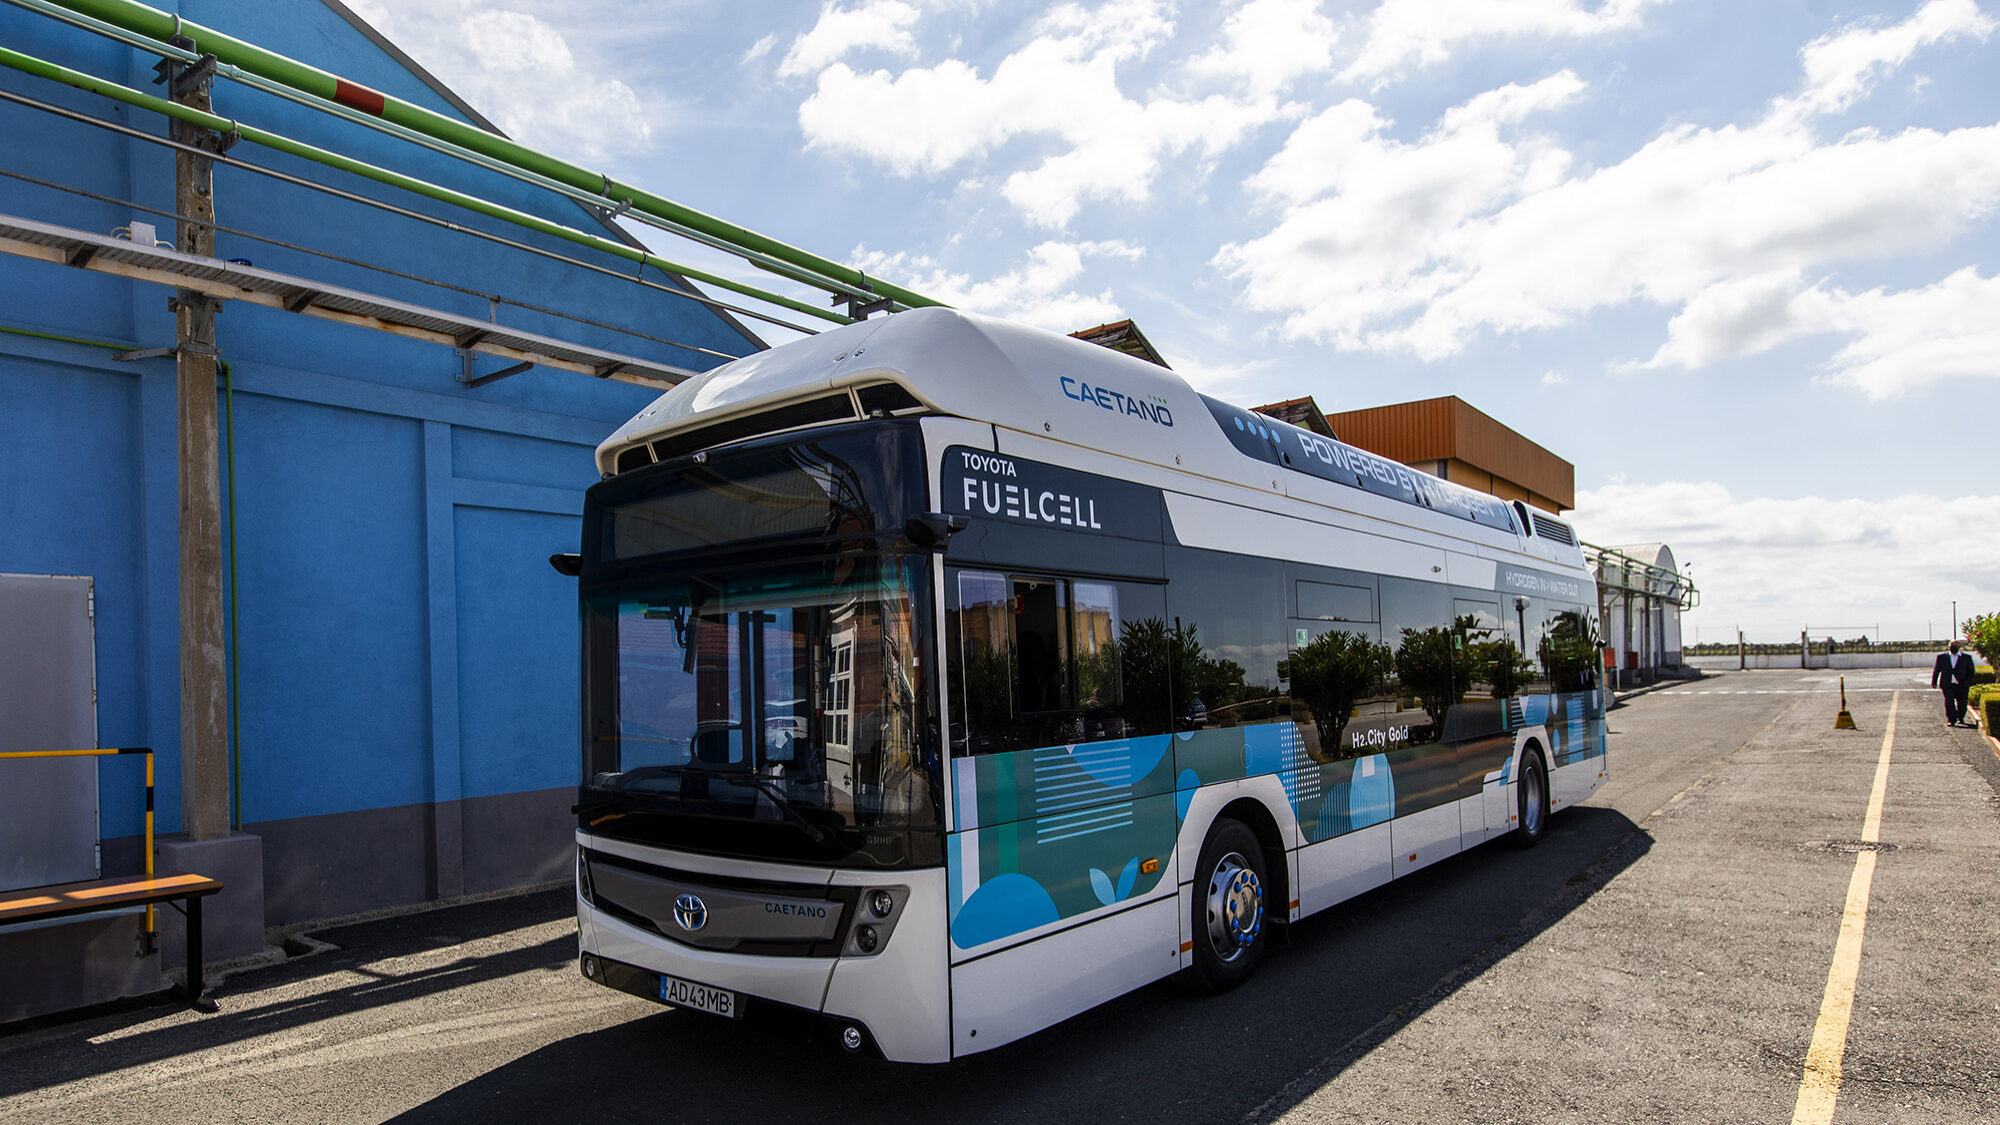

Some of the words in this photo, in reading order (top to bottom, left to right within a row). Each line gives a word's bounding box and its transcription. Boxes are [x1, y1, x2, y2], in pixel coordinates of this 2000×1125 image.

[1060, 376, 1174, 427] CAETANO
[961, 452, 1017, 477] TOYOTA
[1296, 432, 1398, 486] POWERED
[1396, 468, 1420, 495] BY
[1418, 475, 1495, 517] HYDROGEN
[963, 477, 1101, 529] FUELCELL
[1505, 571, 1540, 591] HYDROGEN
[1352, 728, 1387, 749] H2.City
[1388, 724, 1409, 742] Gold
[765, 902, 826, 918] CAETANO
[669, 981, 730, 1013] AD43MB
